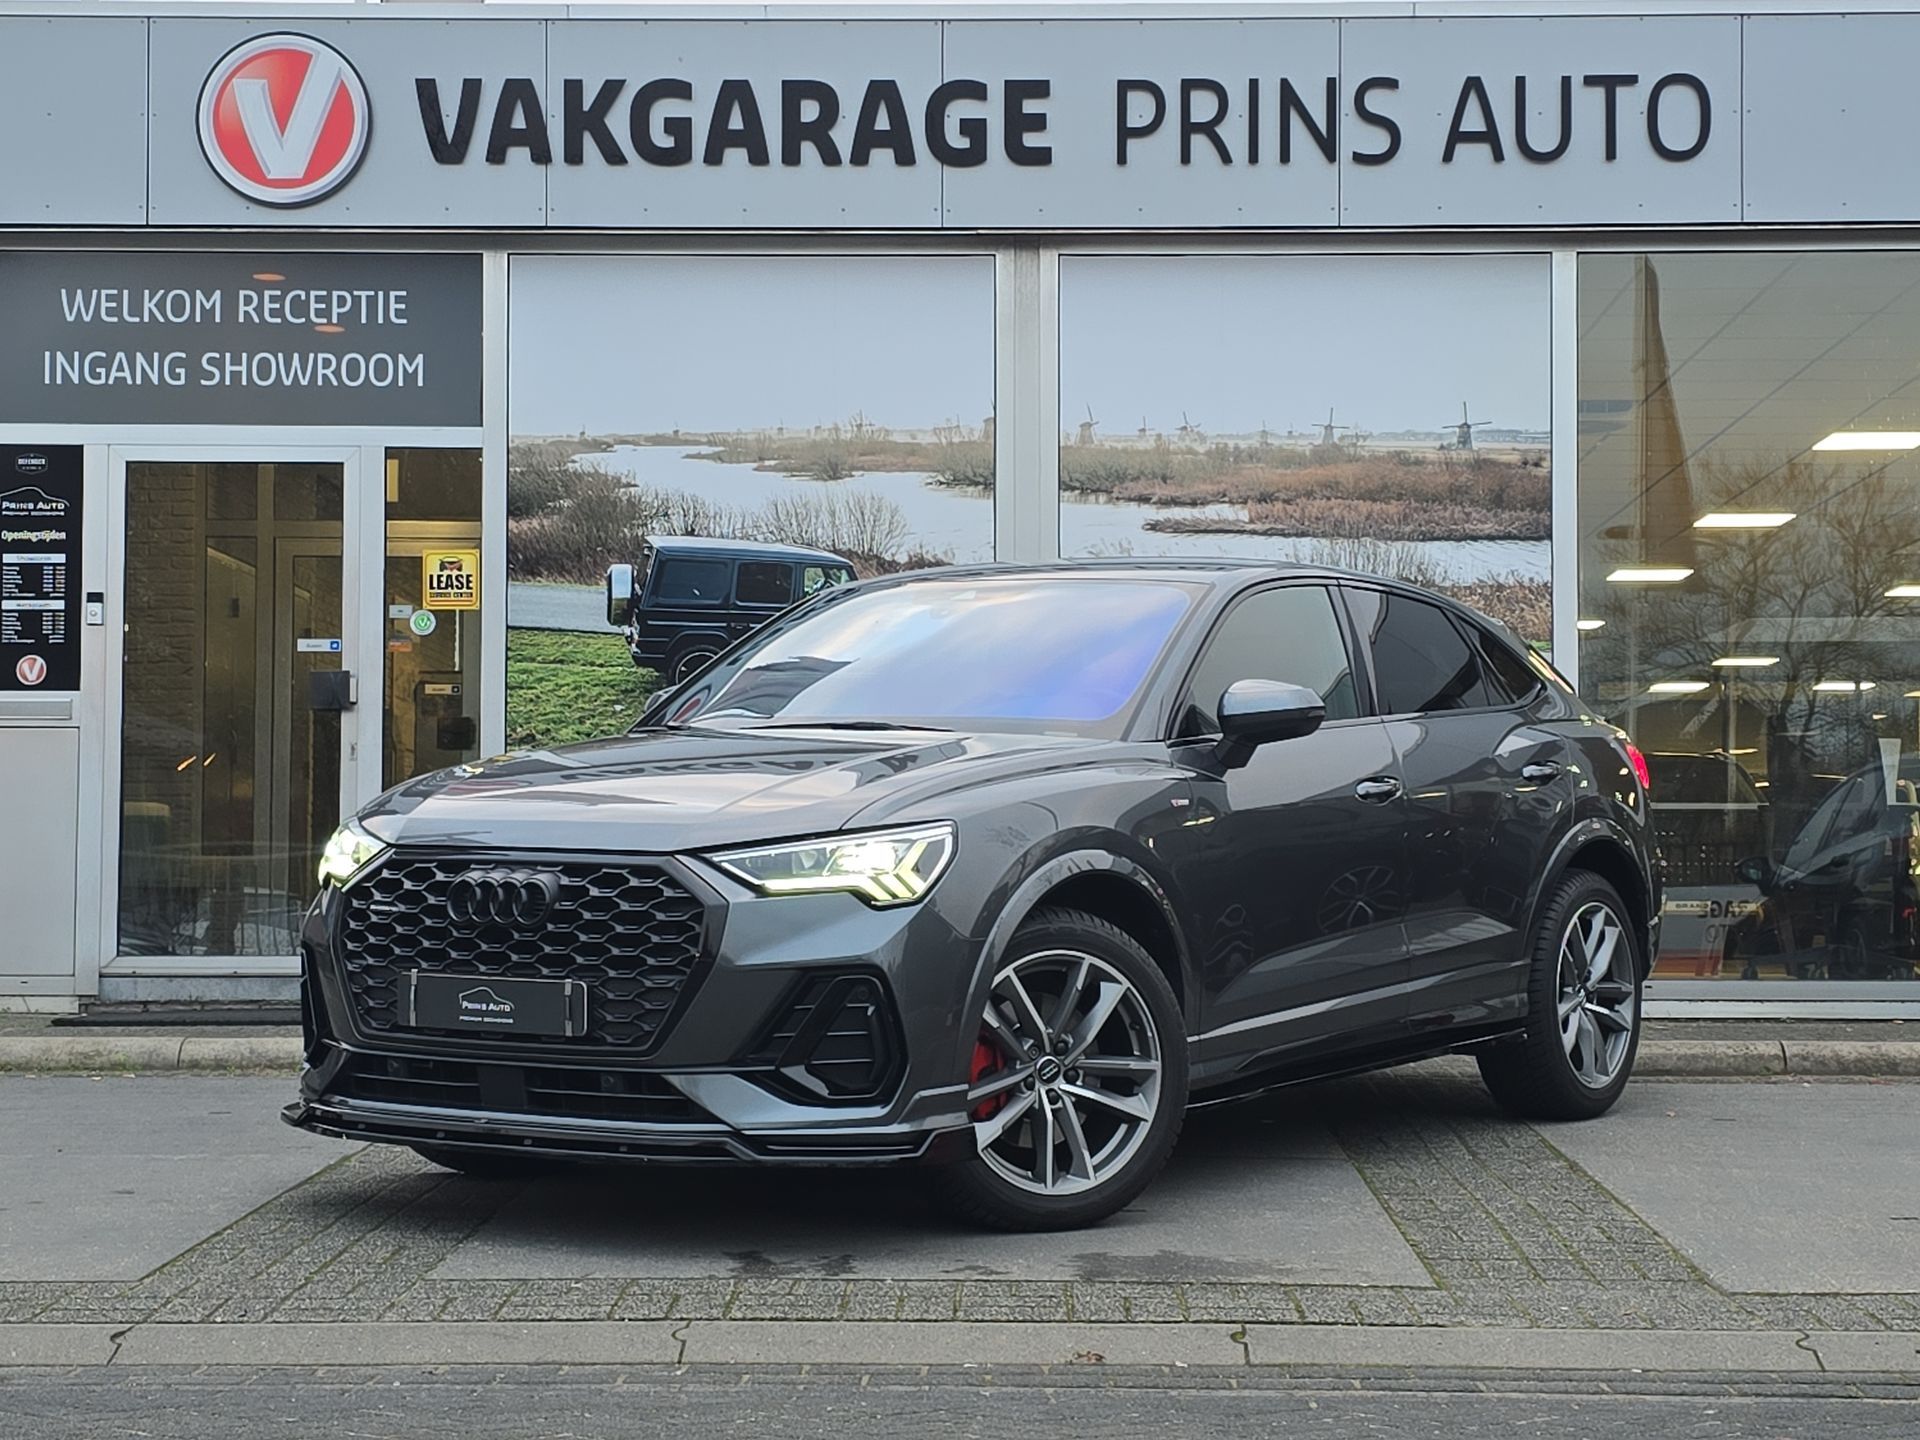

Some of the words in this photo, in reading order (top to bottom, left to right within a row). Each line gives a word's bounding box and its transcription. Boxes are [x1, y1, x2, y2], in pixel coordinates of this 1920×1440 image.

[414, 77, 1054, 168] VAKGARAGE
[1115, 77, 1402, 166] PRINS
[1442, 73, 1713, 164] AUTO
[60, 288, 222, 323] WELKOM
[237, 289, 408, 325] RECEPTIE
[43, 350, 187, 386] INGANG
[200, 352, 425, 388] SHOWROOM
[429, 573, 474, 591] LEASE
